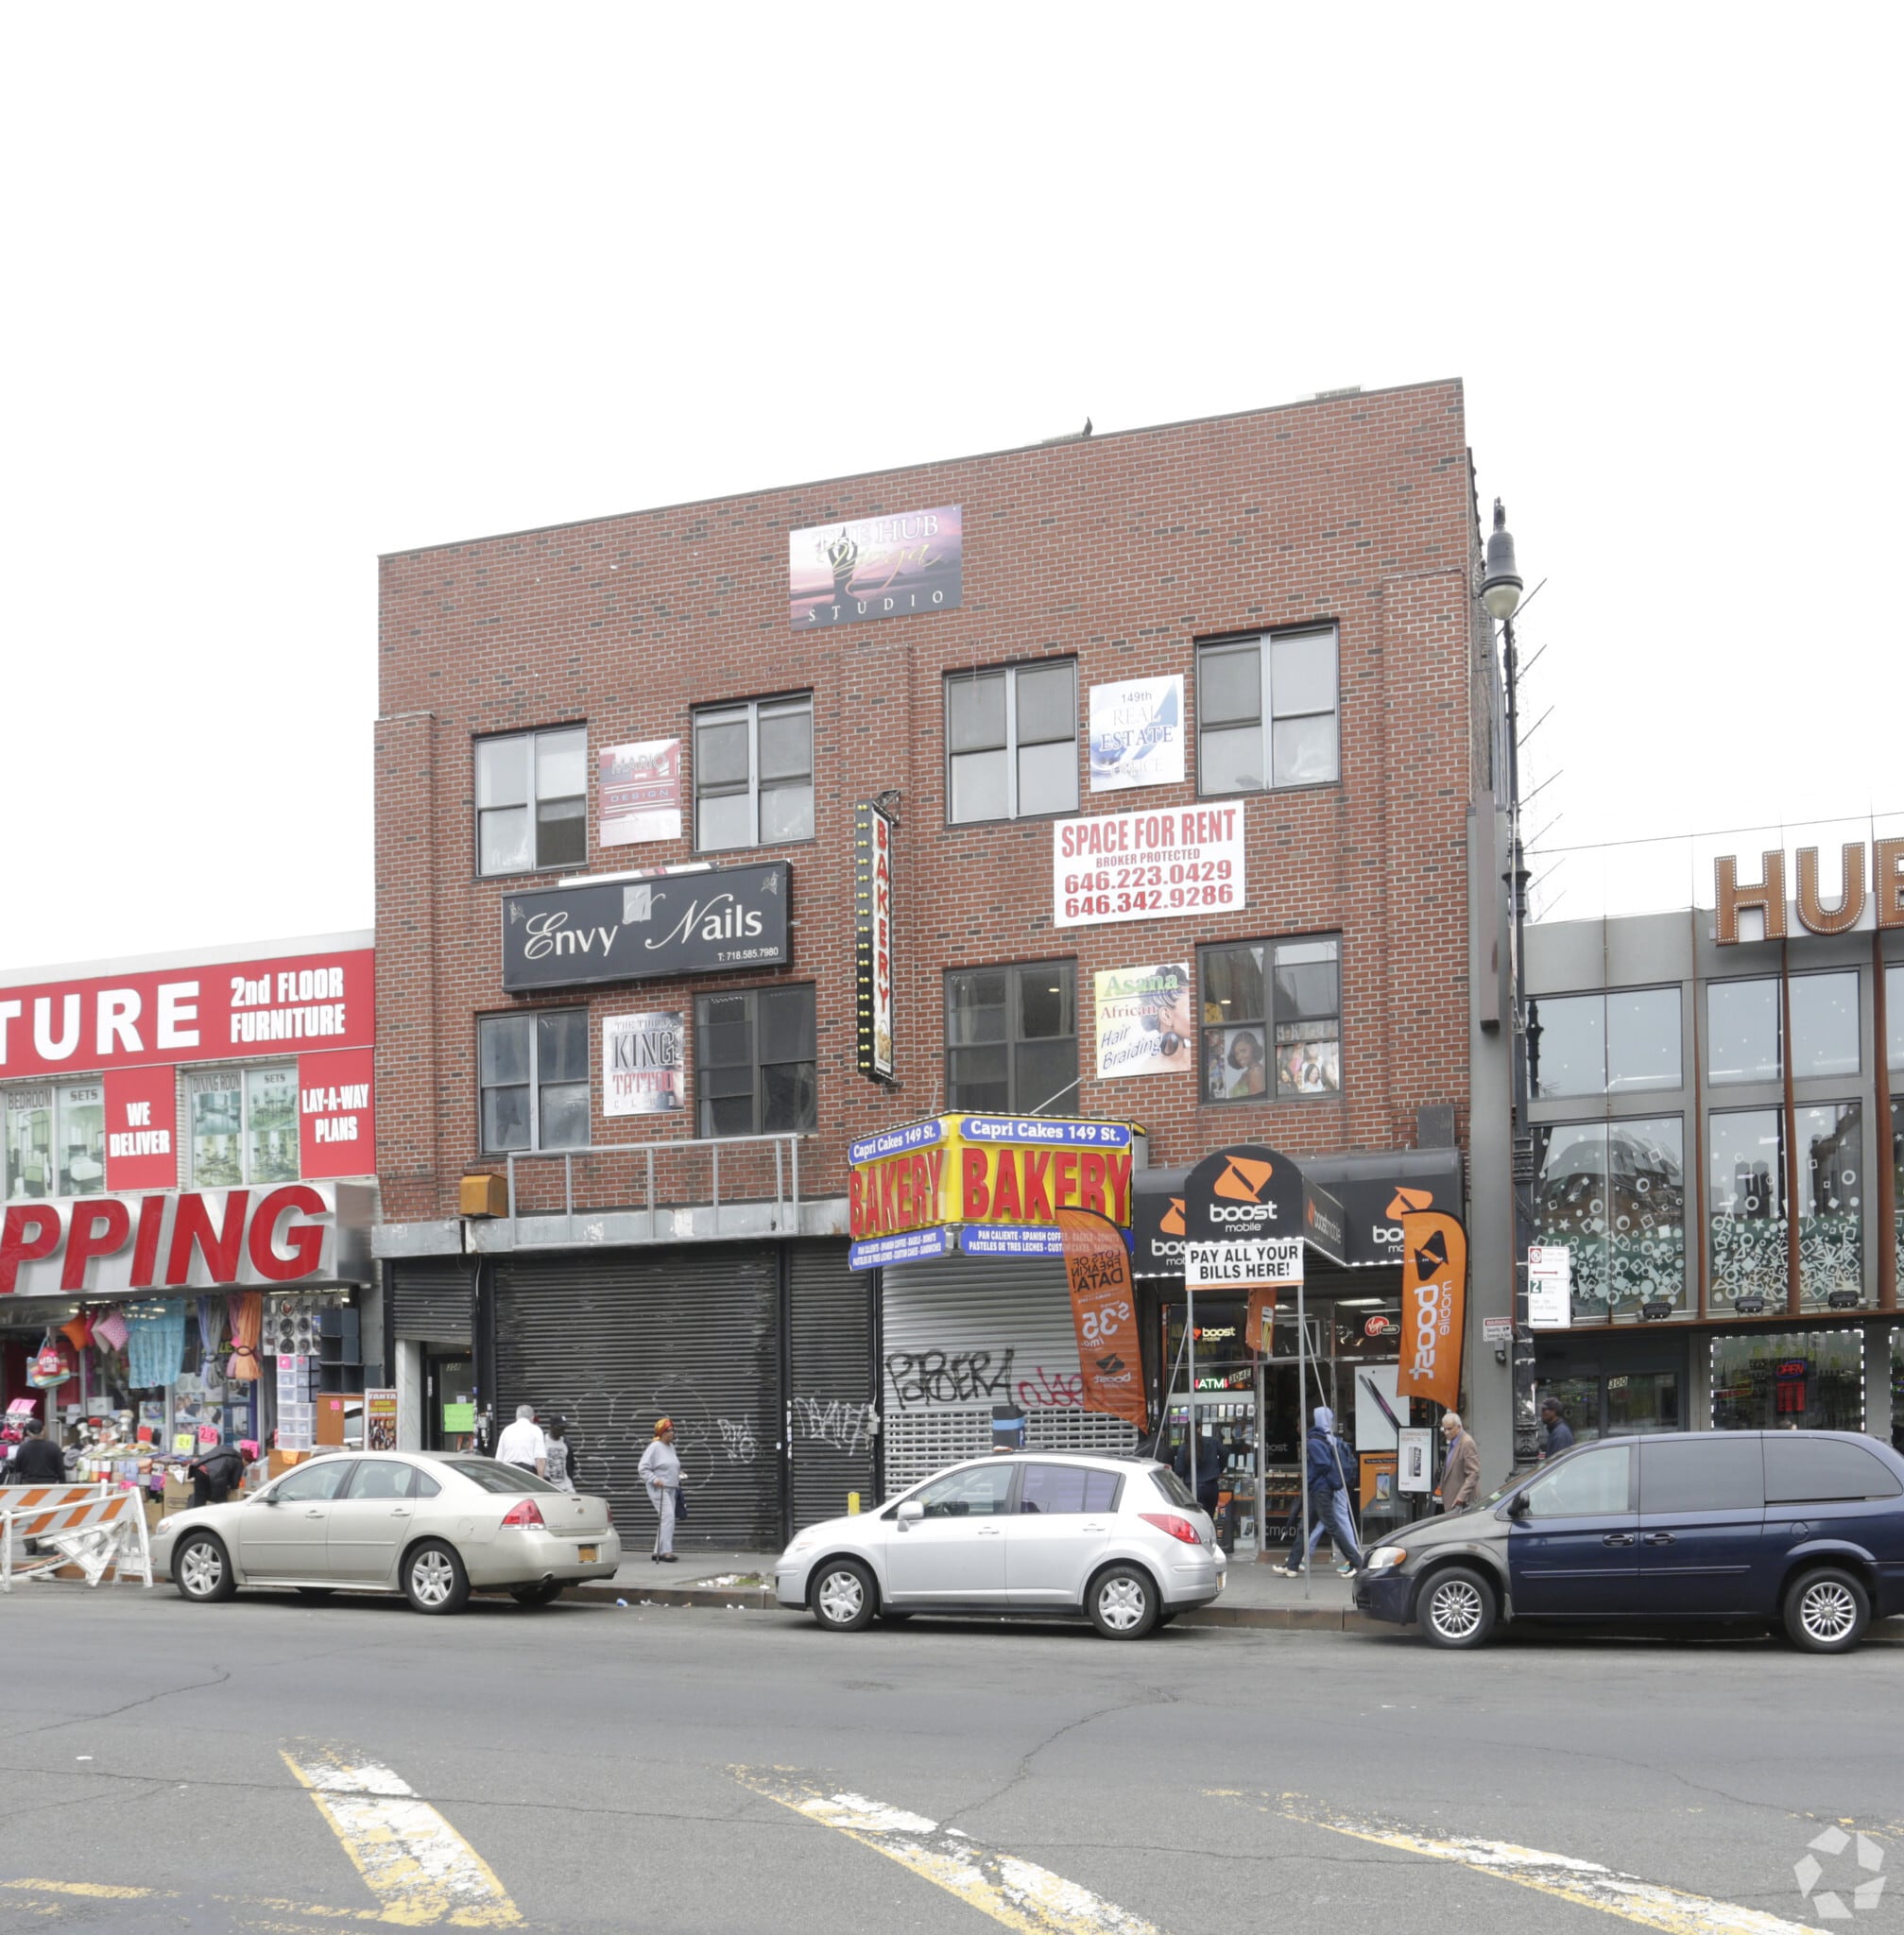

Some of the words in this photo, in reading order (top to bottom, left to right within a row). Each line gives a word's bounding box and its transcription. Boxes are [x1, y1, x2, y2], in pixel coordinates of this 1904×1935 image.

[815, 524, 870, 552] THE
[877, 515, 938, 543] HUB
[809, 591, 943, 622] STUDIO
[1122, 691, 1152, 703] 149th
[1113, 705, 1161, 726] REAL
[1101, 726, 1174, 750] ESTATE
[611, 789, 669, 802] DESIGN
[1062, 818, 1128, 858] SPACE
[1135, 813, 1175, 849] FOR
[1182, 808, 1237, 846] RENT
[1096, 850, 1138, 868] BROKER
[1140, 847, 1200, 865] PROTECTED
[1065, 859, 1232, 894] 646.223.0429
[1065, 883, 1234, 917] 646.342.9286
[524, 912, 618, 959] Envy
[644, 894, 763, 949] Nails
[877, 818, 889, 1014] BAKERY
[726, 946, 779, 961] 718.585.7980
[231, 975, 270, 1007] 2nd
[278, 967, 344, 1003] FLOOR
[1105, 973, 1179, 998] Asana
[231, 1003, 345, 1044] FURNITURE
[1101, 1002, 1158, 1021] African
[1101, 1024, 1130, 1047] Hair
[612, 1031, 675, 1069] KING
[1103, 1033, 1163, 1070] Braiding
[265, 1073, 285, 1084] SETS
[613, 1070, 674, 1096] TATTOO
[70, 1088, 98, 1102] SETS
[302, 1084, 369, 1113] LAY-A-WAY
[127, 1102, 150, 1126] WE
[315, 1116, 358, 1143] PLANS
[970, 1121, 1013, 1139] Capri
[1018, 1122, 1063, 1139] Cakes
[1068, 1124, 1096, 1140] 149
[1101, 1127, 1121, 1142] St.
[110, 1130, 170, 1157] DELIVER
[854, 1140, 876, 1158] Capri
[877, 1135, 903, 1153] Cakes
[904, 1130, 923, 1145] 149
[849, 1149, 944, 1238] BAKERY
[962, 1147, 1133, 1223] BAKERY
[1209, 1201, 1278, 1223] boost
[0, 1184, 327, 1294] PPING
[978, 1230, 990, 1240] PAN
[991, 1231, 1019, 1241] CALIENTE
[1022, 1231, 1046, 1241] SPANISH
[1226, 1223, 1261, 1233] mobile
[969, 1241, 997, 1251] PASTELES
[998, 1242, 1005, 1251] DE
[1007, 1242, 1021, 1251] TRES
[1022, 1242, 1044, 1252] LECHES
[1191, 1249, 1219, 1263] PAY
[1225, 1248, 1251, 1262] ALL
[1257, 1246, 1298, 1260] YOUR
[1200, 1264, 1241, 1279] BILLS
[1245, 1262, 1290, 1278] HERE!
[1202, 1327, 1236, 1337] boost
[1776, 1362, 1804, 1376] OPEN
[1198, 1378, 1225, 1389] ATM
[1608, 1377, 1628, 1388] 300
